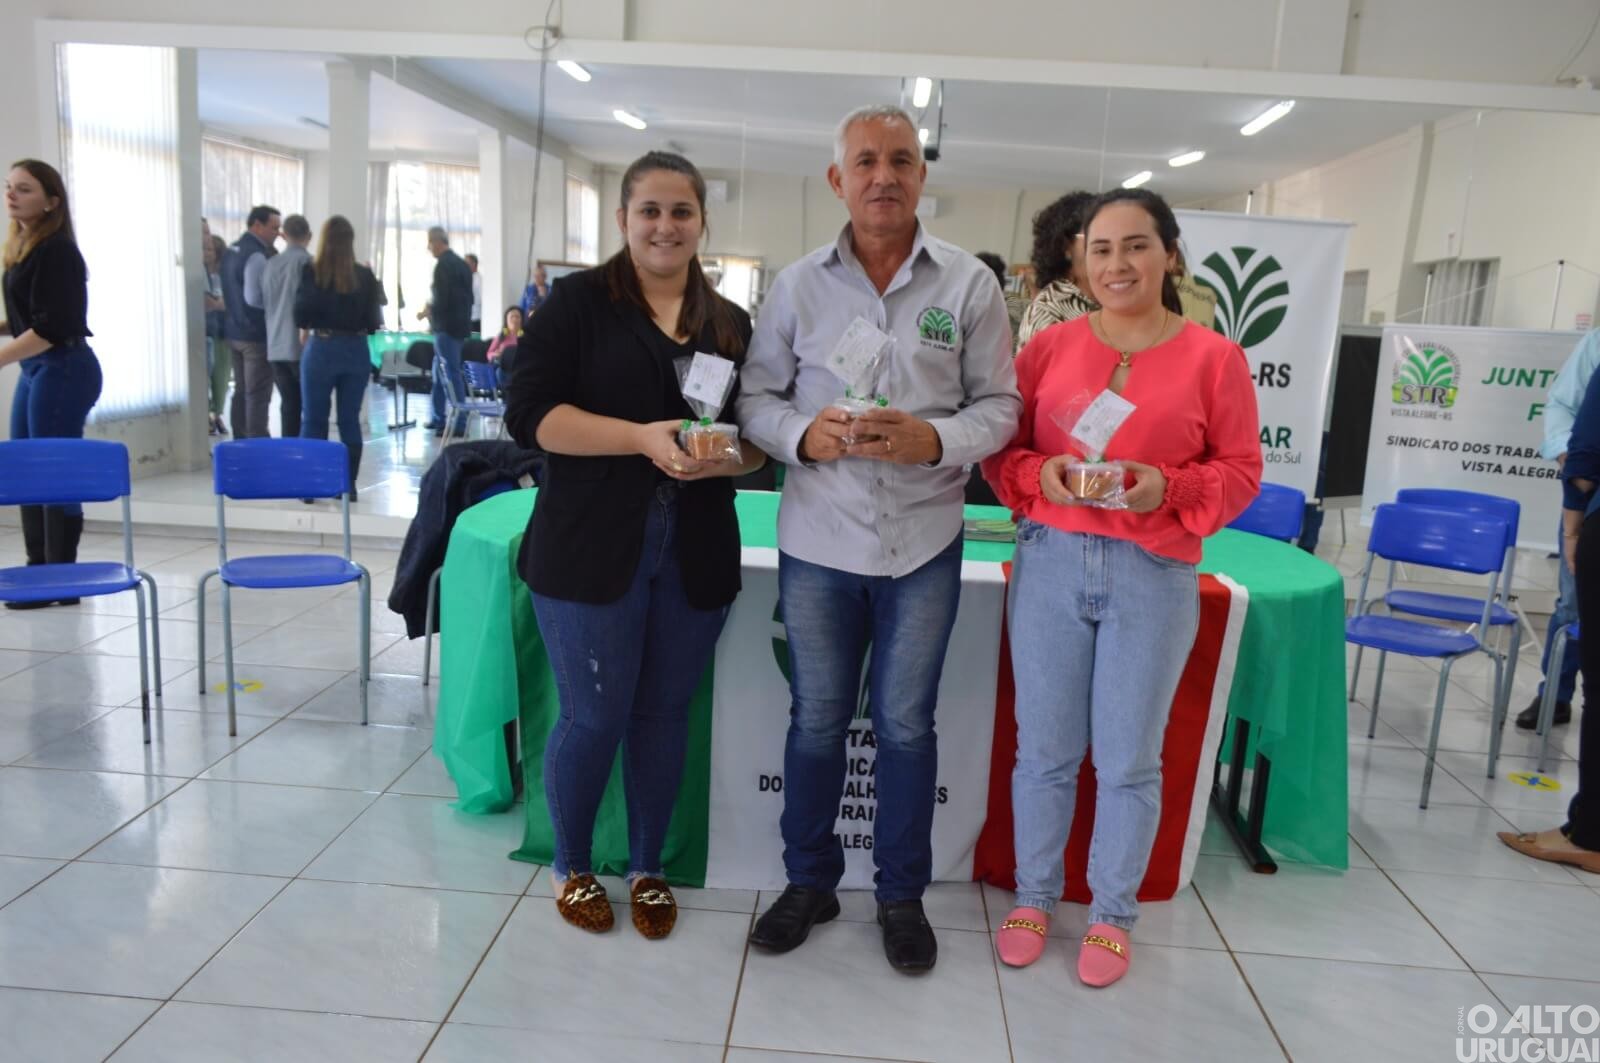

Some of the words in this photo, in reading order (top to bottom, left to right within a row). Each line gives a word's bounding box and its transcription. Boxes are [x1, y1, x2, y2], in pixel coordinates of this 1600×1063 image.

[1481, 366, 1559, 388] JUNT
[1386, 435, 1459, 452] SINDICATO
[1462, 442, 1491, 455] DOS
[1283, 451, 1302, 465] Sul
[1461, 460, 1503, 474] VISTA
